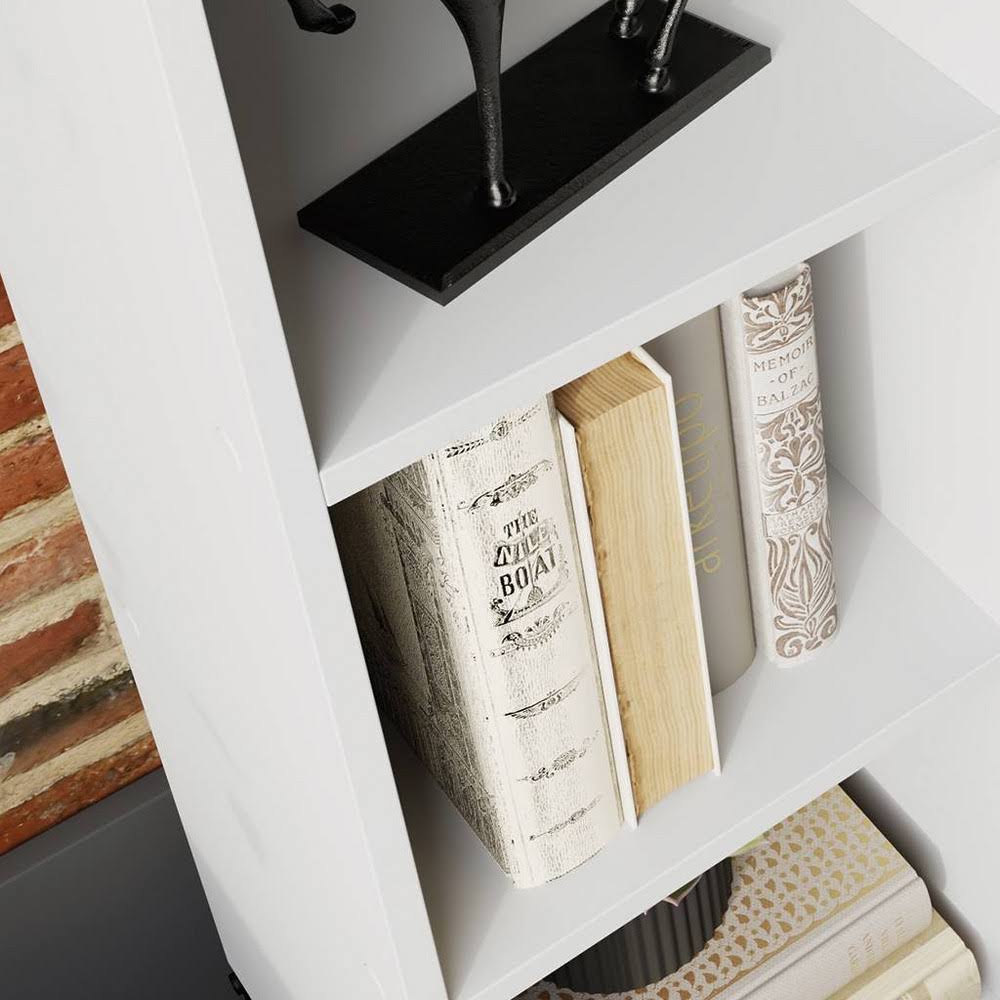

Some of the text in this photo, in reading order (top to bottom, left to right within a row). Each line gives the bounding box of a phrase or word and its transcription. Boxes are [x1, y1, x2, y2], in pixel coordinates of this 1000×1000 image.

[753, 335, 814, 373] MEMOIR
[757, 372, 815, 407] BALZAC
[503, 508, 539, 539] THE
[493, 524, 556, 567] NILE
[500, 546, 557, 597] BOAT
